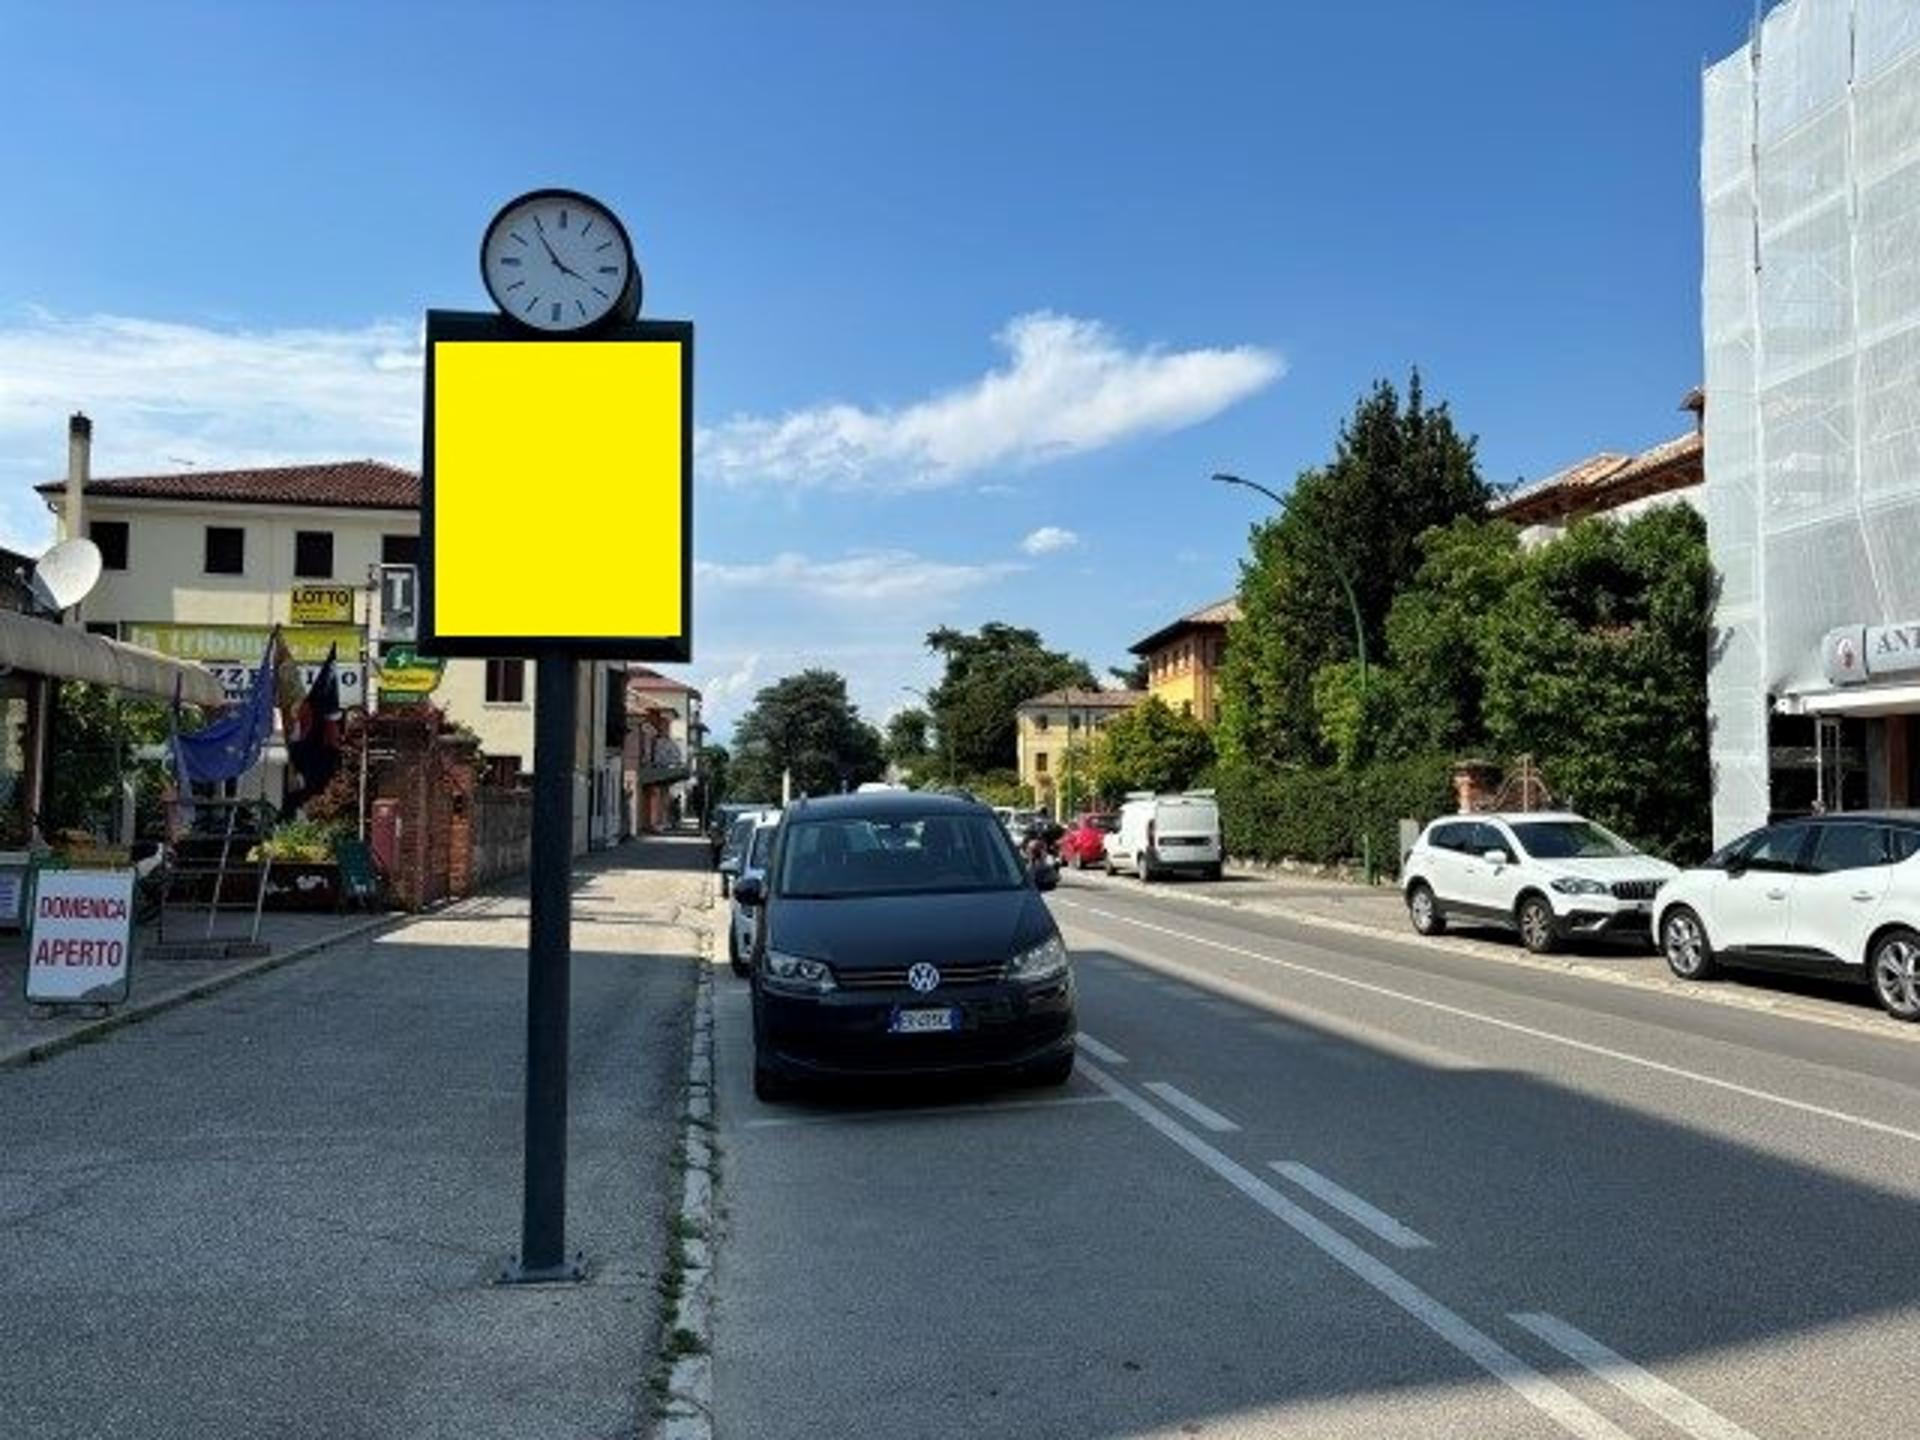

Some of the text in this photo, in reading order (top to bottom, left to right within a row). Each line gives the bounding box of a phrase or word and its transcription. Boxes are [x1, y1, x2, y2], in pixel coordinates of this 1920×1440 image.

[292, 590, 349, 606] LOTTO
[40, 896, 127, 919] DOMENICA
[35, 938, 124, 967] APERTO
